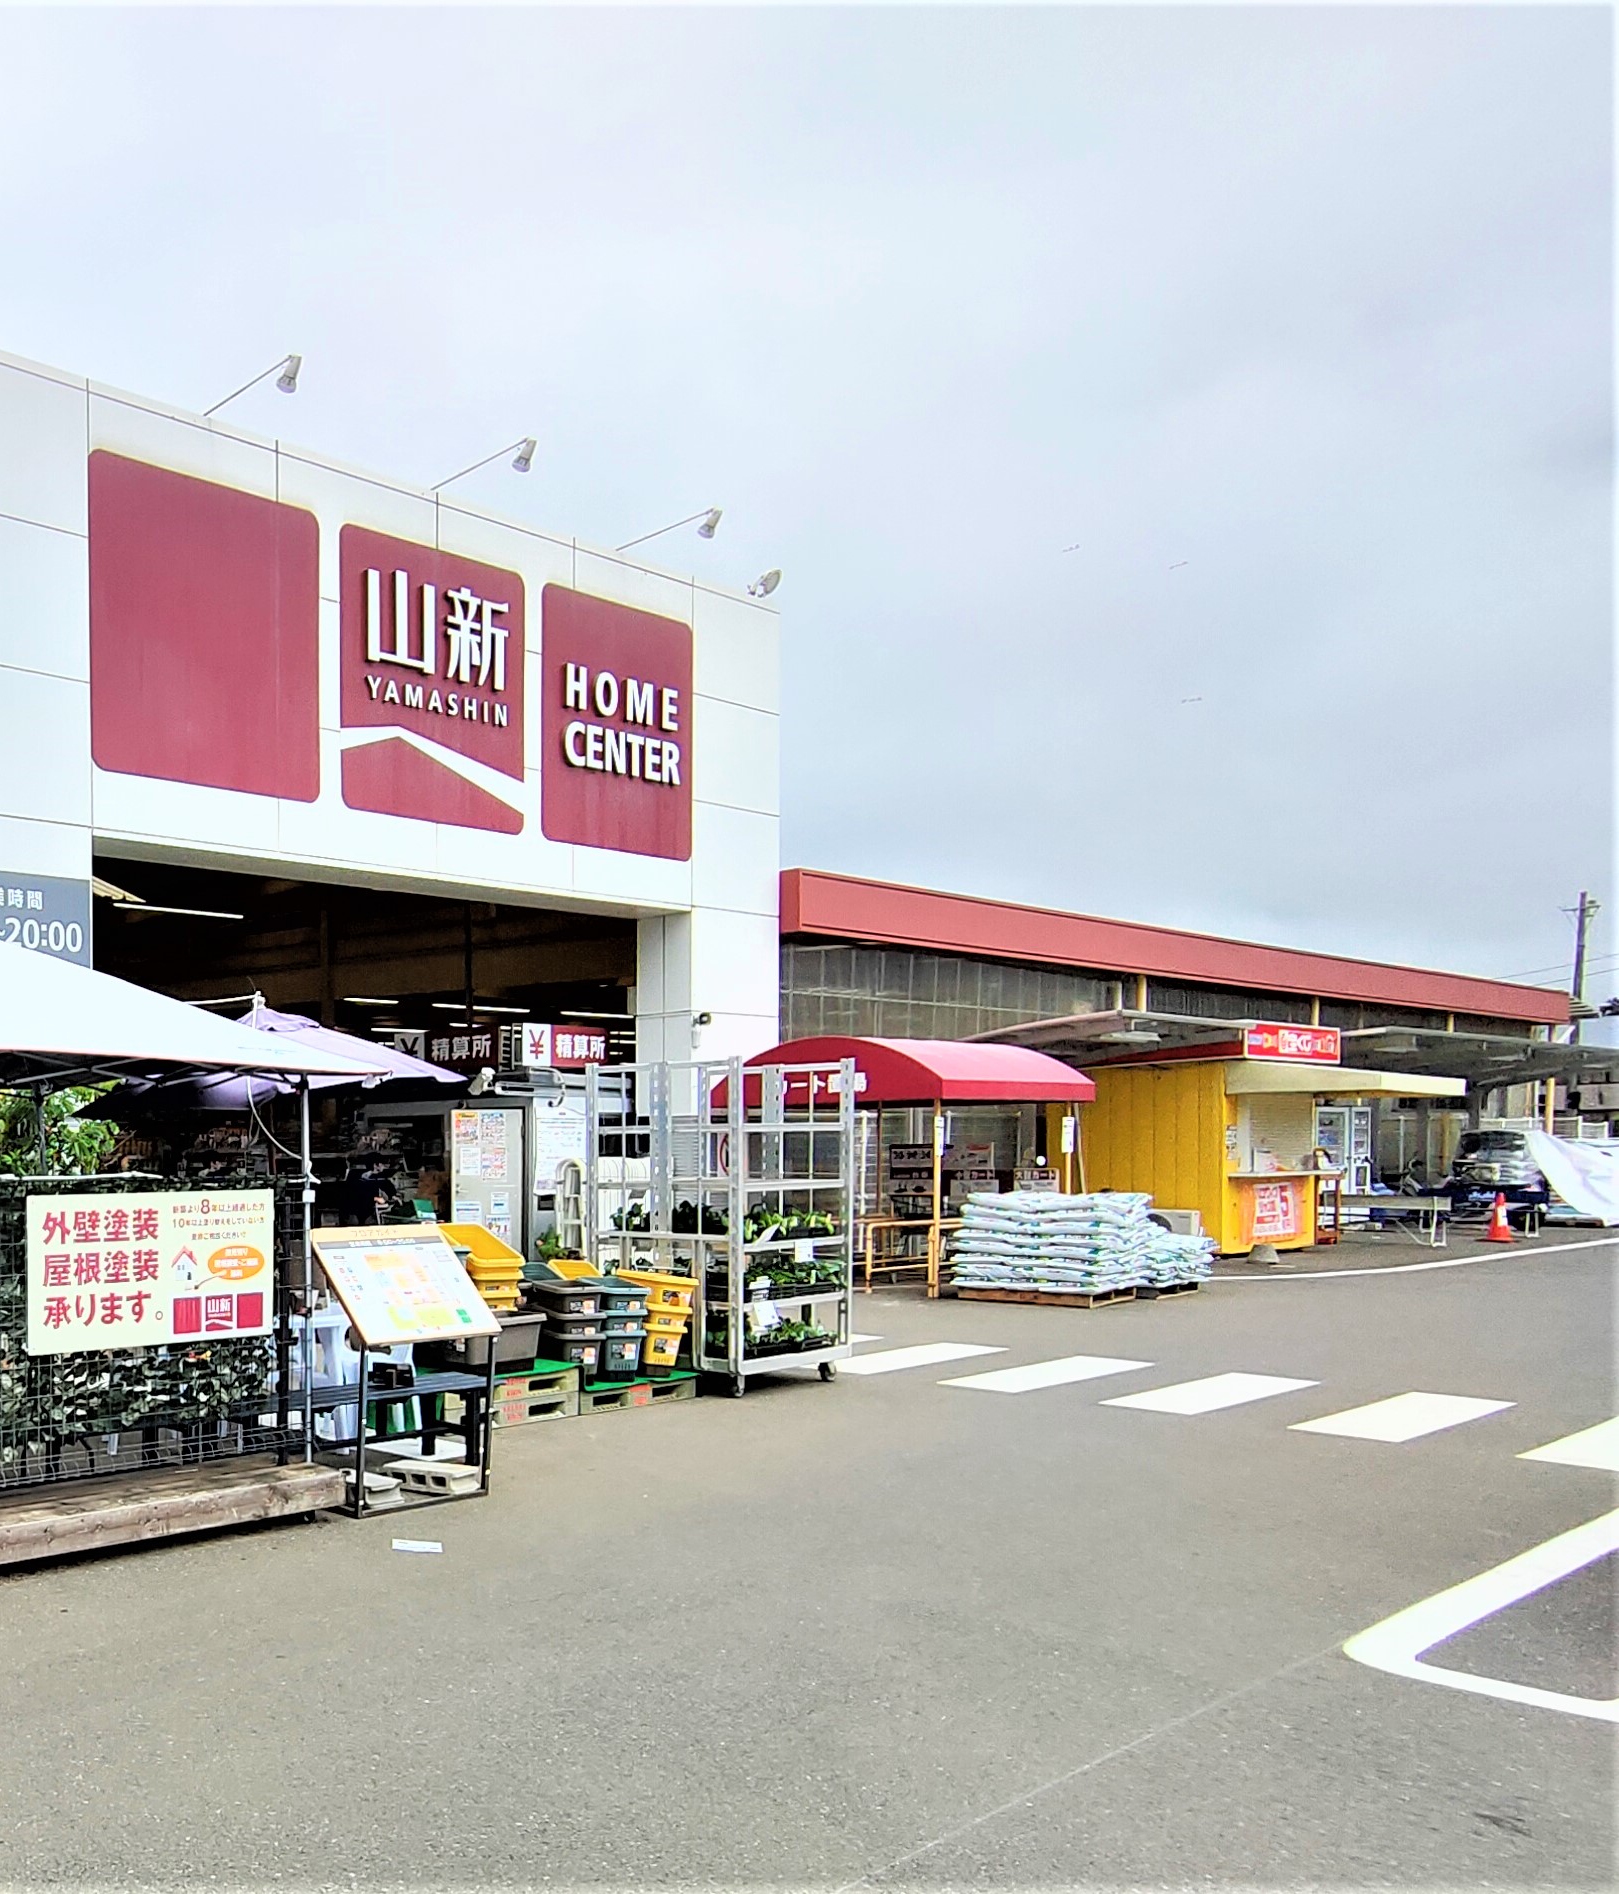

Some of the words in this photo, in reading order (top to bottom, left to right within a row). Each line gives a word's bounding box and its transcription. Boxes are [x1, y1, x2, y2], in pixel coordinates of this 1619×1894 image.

[366, 568, 509, 691] 山新
[366, 675, 509, 727] YAMASHIN
[565, 661, 679, 731] HOME
[563, 720, 681, 785] CENTER
[431, 1033, 492, 1062] 精算所
[555, 1033, 606, 1060] 精算所
[42, 1208, 159, 1245] 外壁塗装
[42, 1249, 159, 1287] 屋根塗装
